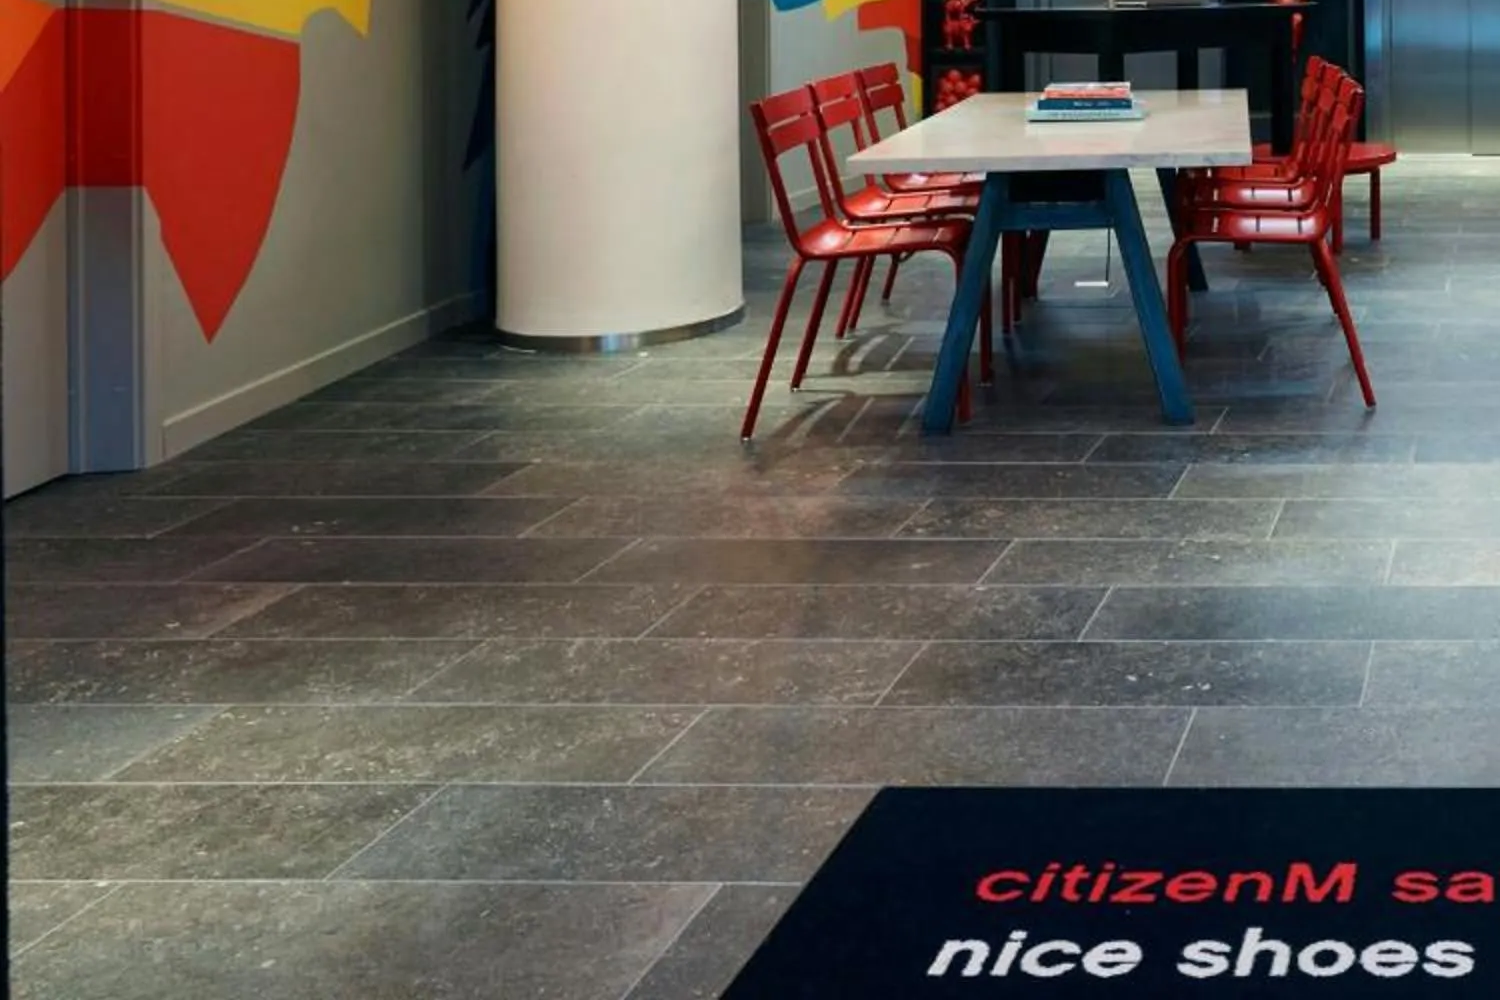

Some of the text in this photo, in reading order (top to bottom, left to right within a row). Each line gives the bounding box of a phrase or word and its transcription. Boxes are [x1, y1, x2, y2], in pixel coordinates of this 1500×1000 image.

[977, 863, 1356, 902] citizenM
[927, 927, 1475, 978] nice shoes
